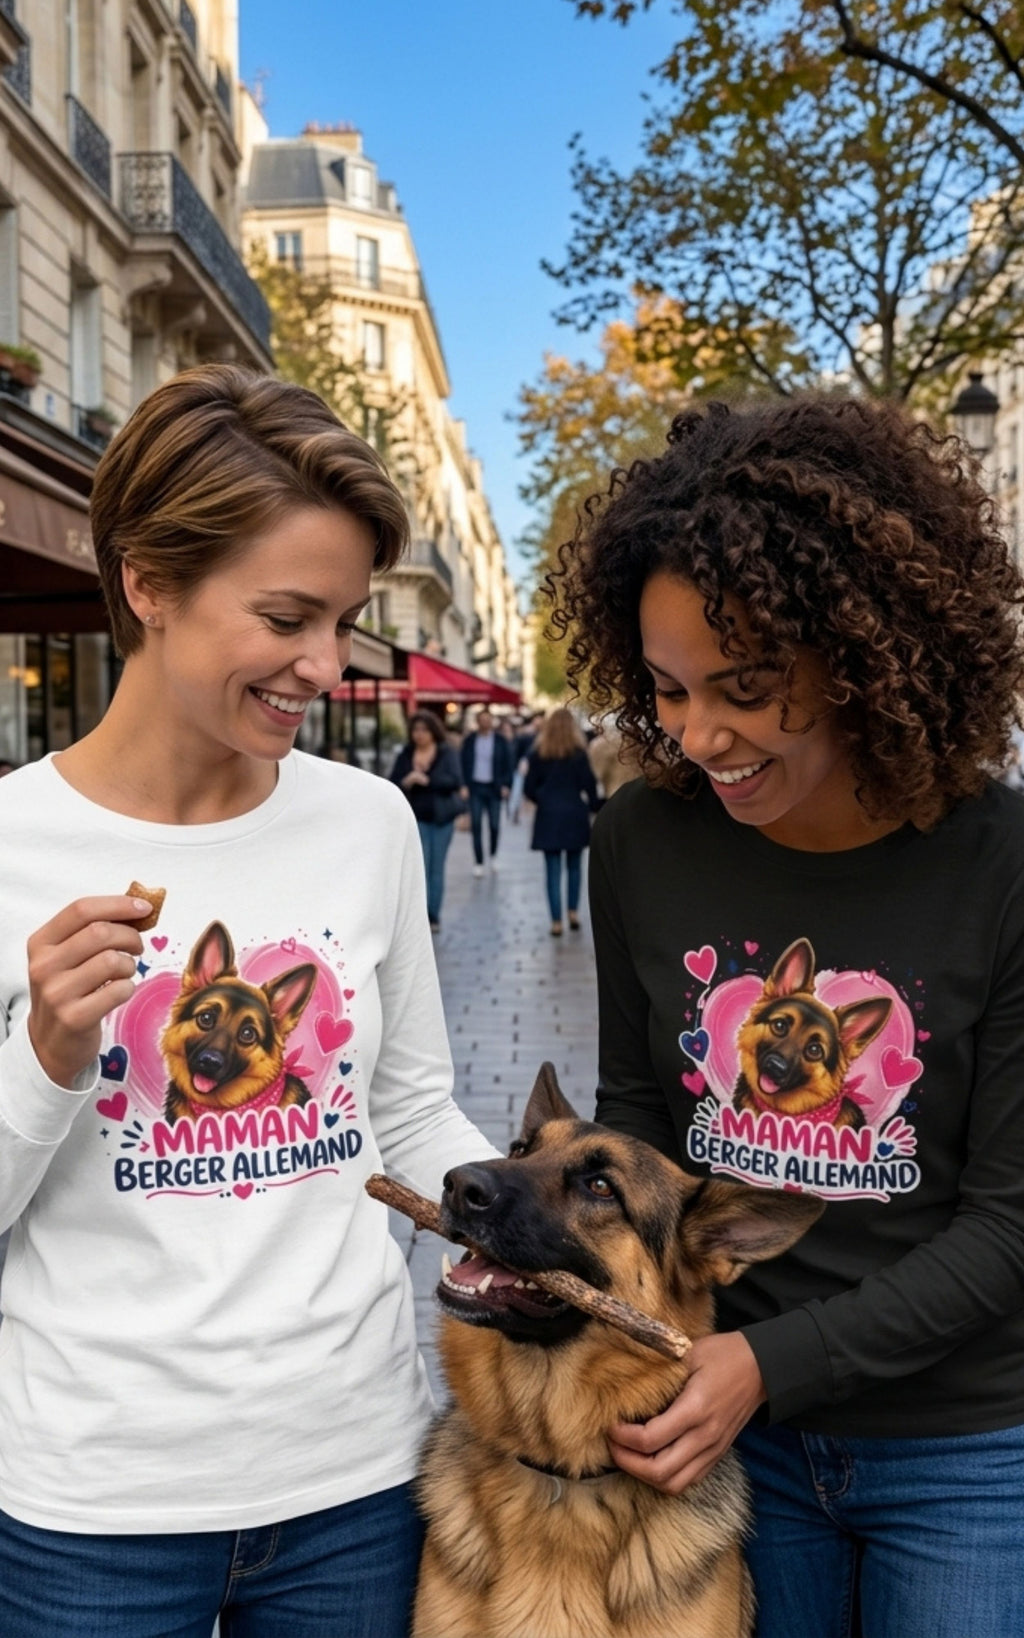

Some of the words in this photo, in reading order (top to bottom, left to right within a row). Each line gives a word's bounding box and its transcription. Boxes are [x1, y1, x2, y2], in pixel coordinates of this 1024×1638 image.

[152, 1102, 318, 1157] MAMAN
[690, 1128, 778, 1177] BERGER
[784, 1157, 917, 1190] ALLEMAND
[721, 1107, 872, 1163] MAMAN
[114, 1157, 226, 1192] BERGER
[232, 1129, 363, 1181] ALLEMAND
